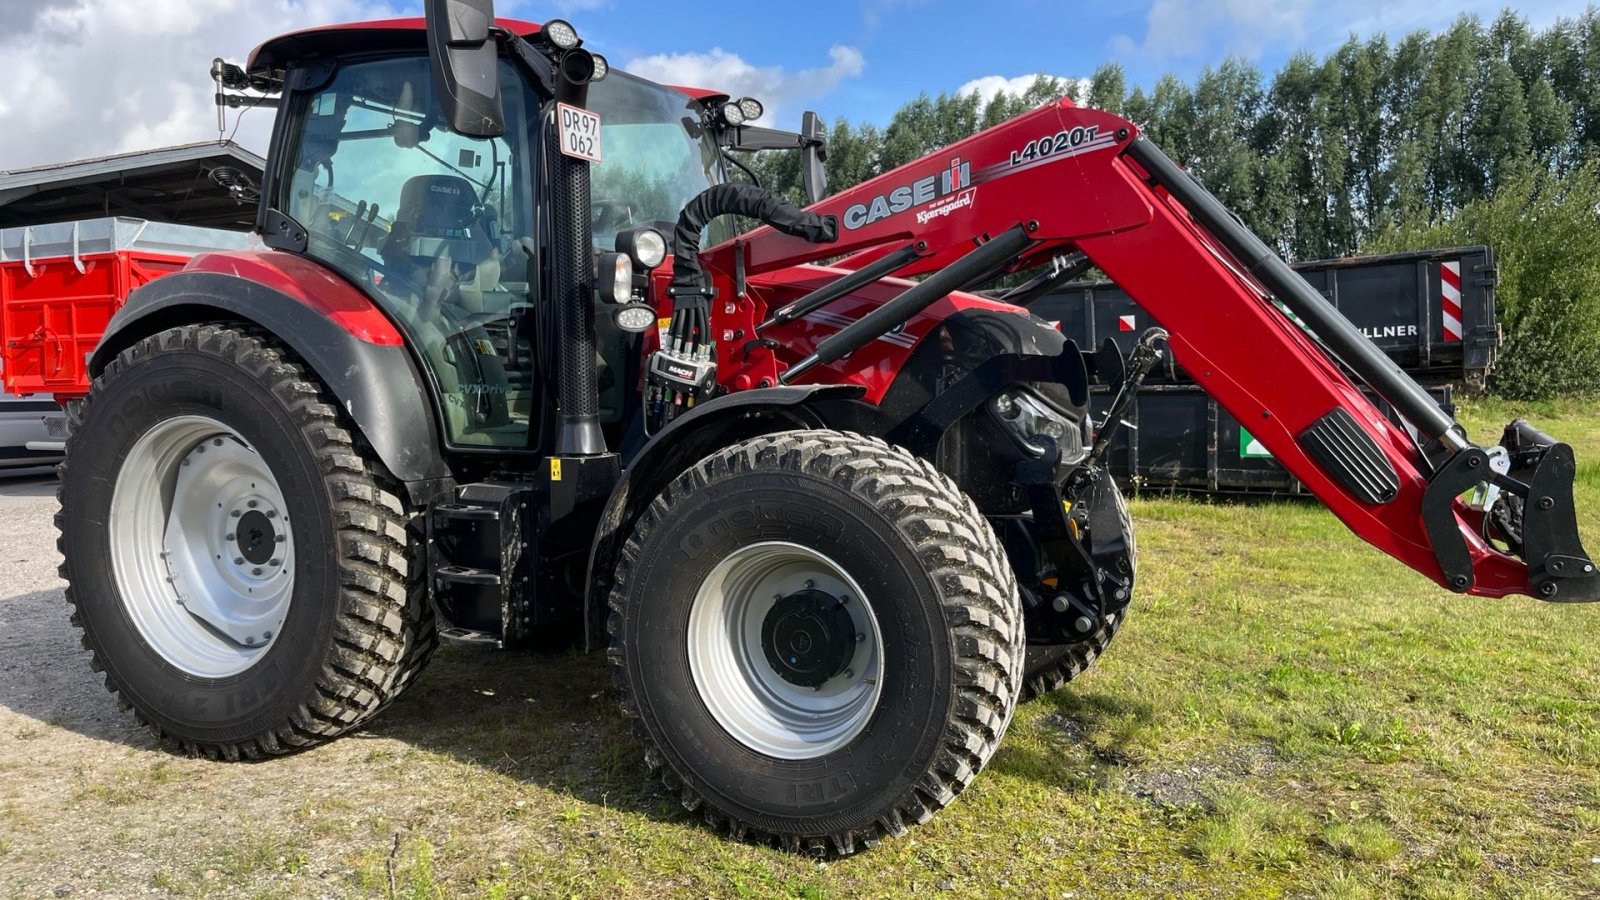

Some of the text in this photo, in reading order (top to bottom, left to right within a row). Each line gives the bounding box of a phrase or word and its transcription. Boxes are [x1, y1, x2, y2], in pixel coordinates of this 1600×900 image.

[570, 132, 593, 157] 062
[1010, 125, 1099, 167] L4020T
[431, 185, 452, 194] CASE
[843, 175, 935, 230] CASE
[916, 193, 970, 225] Kjærsgaard
[1358, 325, 1417, 339] LLNER
[668, 366, 693, 377] MACH
